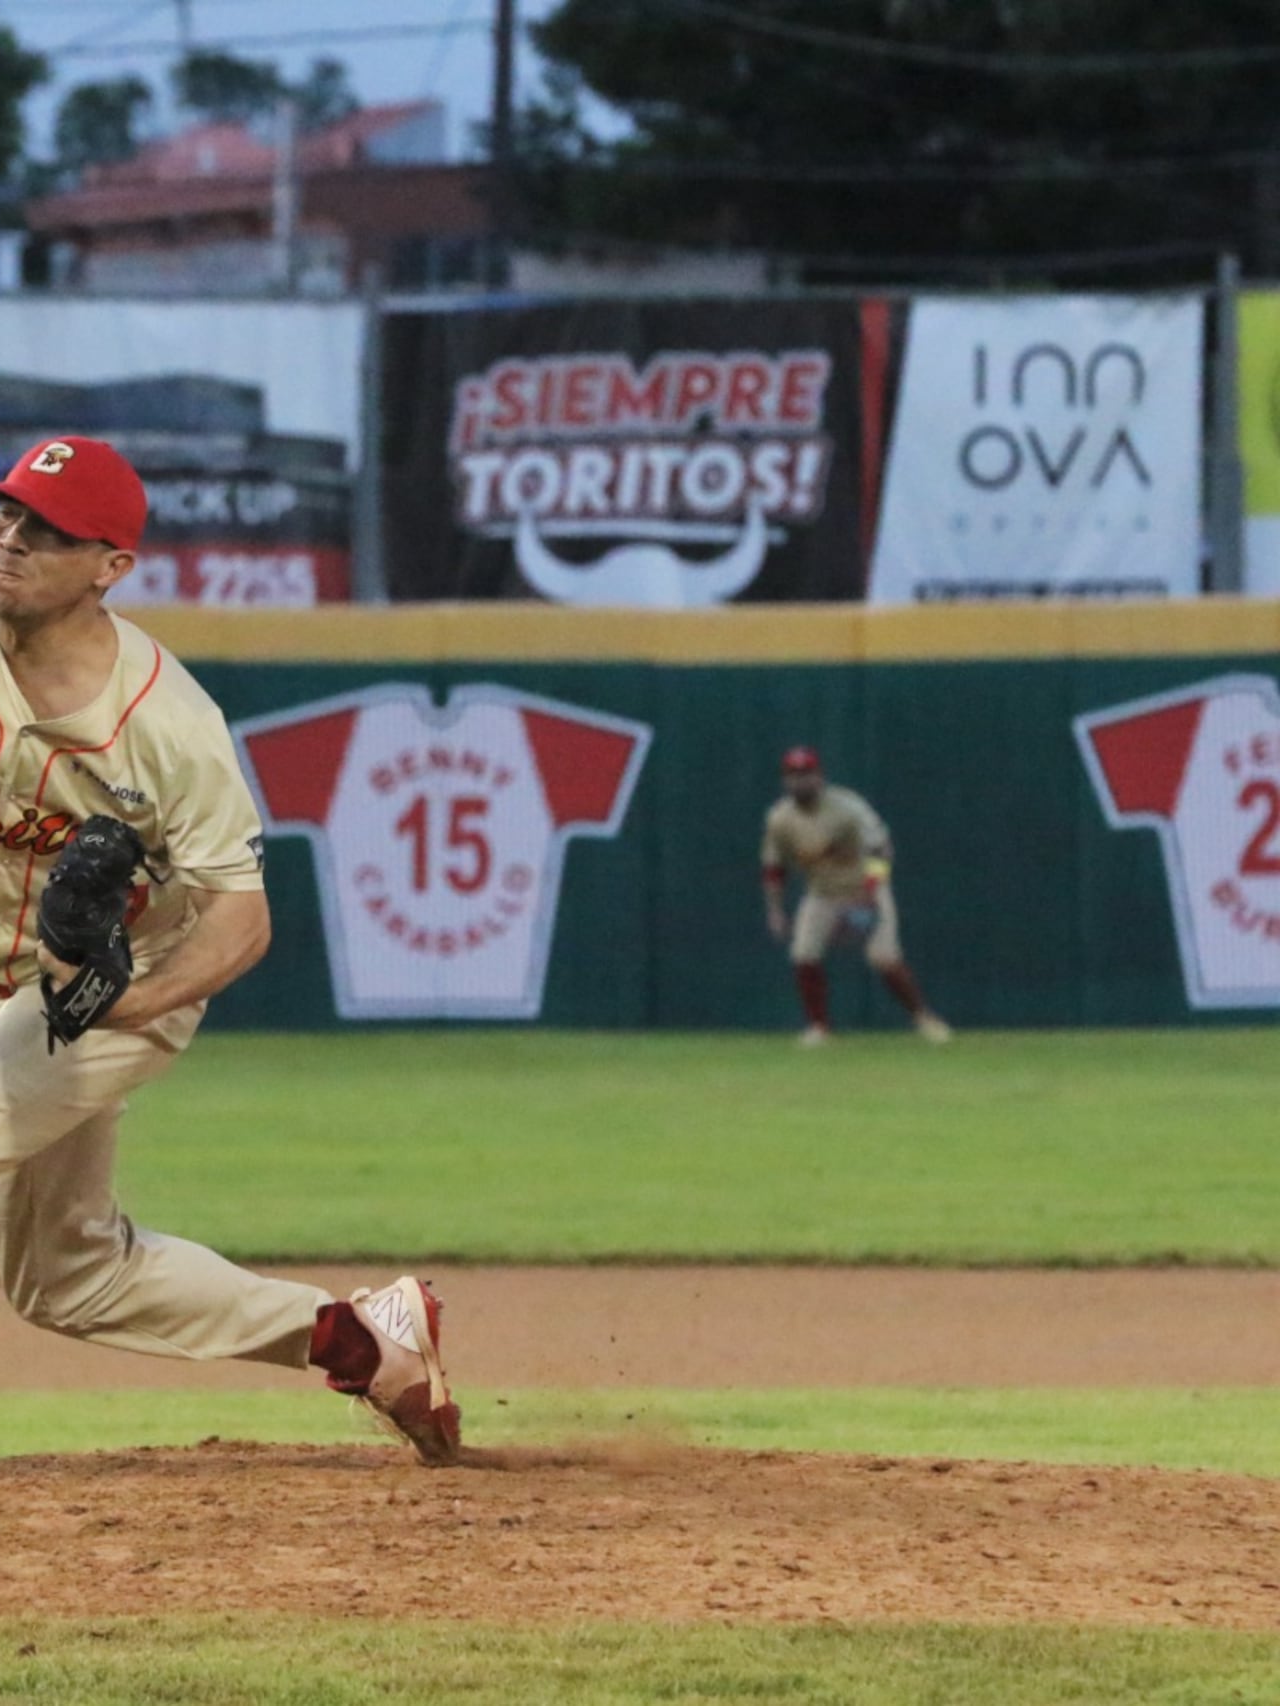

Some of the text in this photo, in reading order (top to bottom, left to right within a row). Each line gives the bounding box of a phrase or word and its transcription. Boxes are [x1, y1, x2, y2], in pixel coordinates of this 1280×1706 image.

[460, 358, 825, 445] ¡SIEMPRE
[460, 441, 826, 522] TORITOS!
[368, 745, 515, 796] BENNY
[393, 791, 491, 895] 15
[352, 861, 534, 958] CARABALLO
